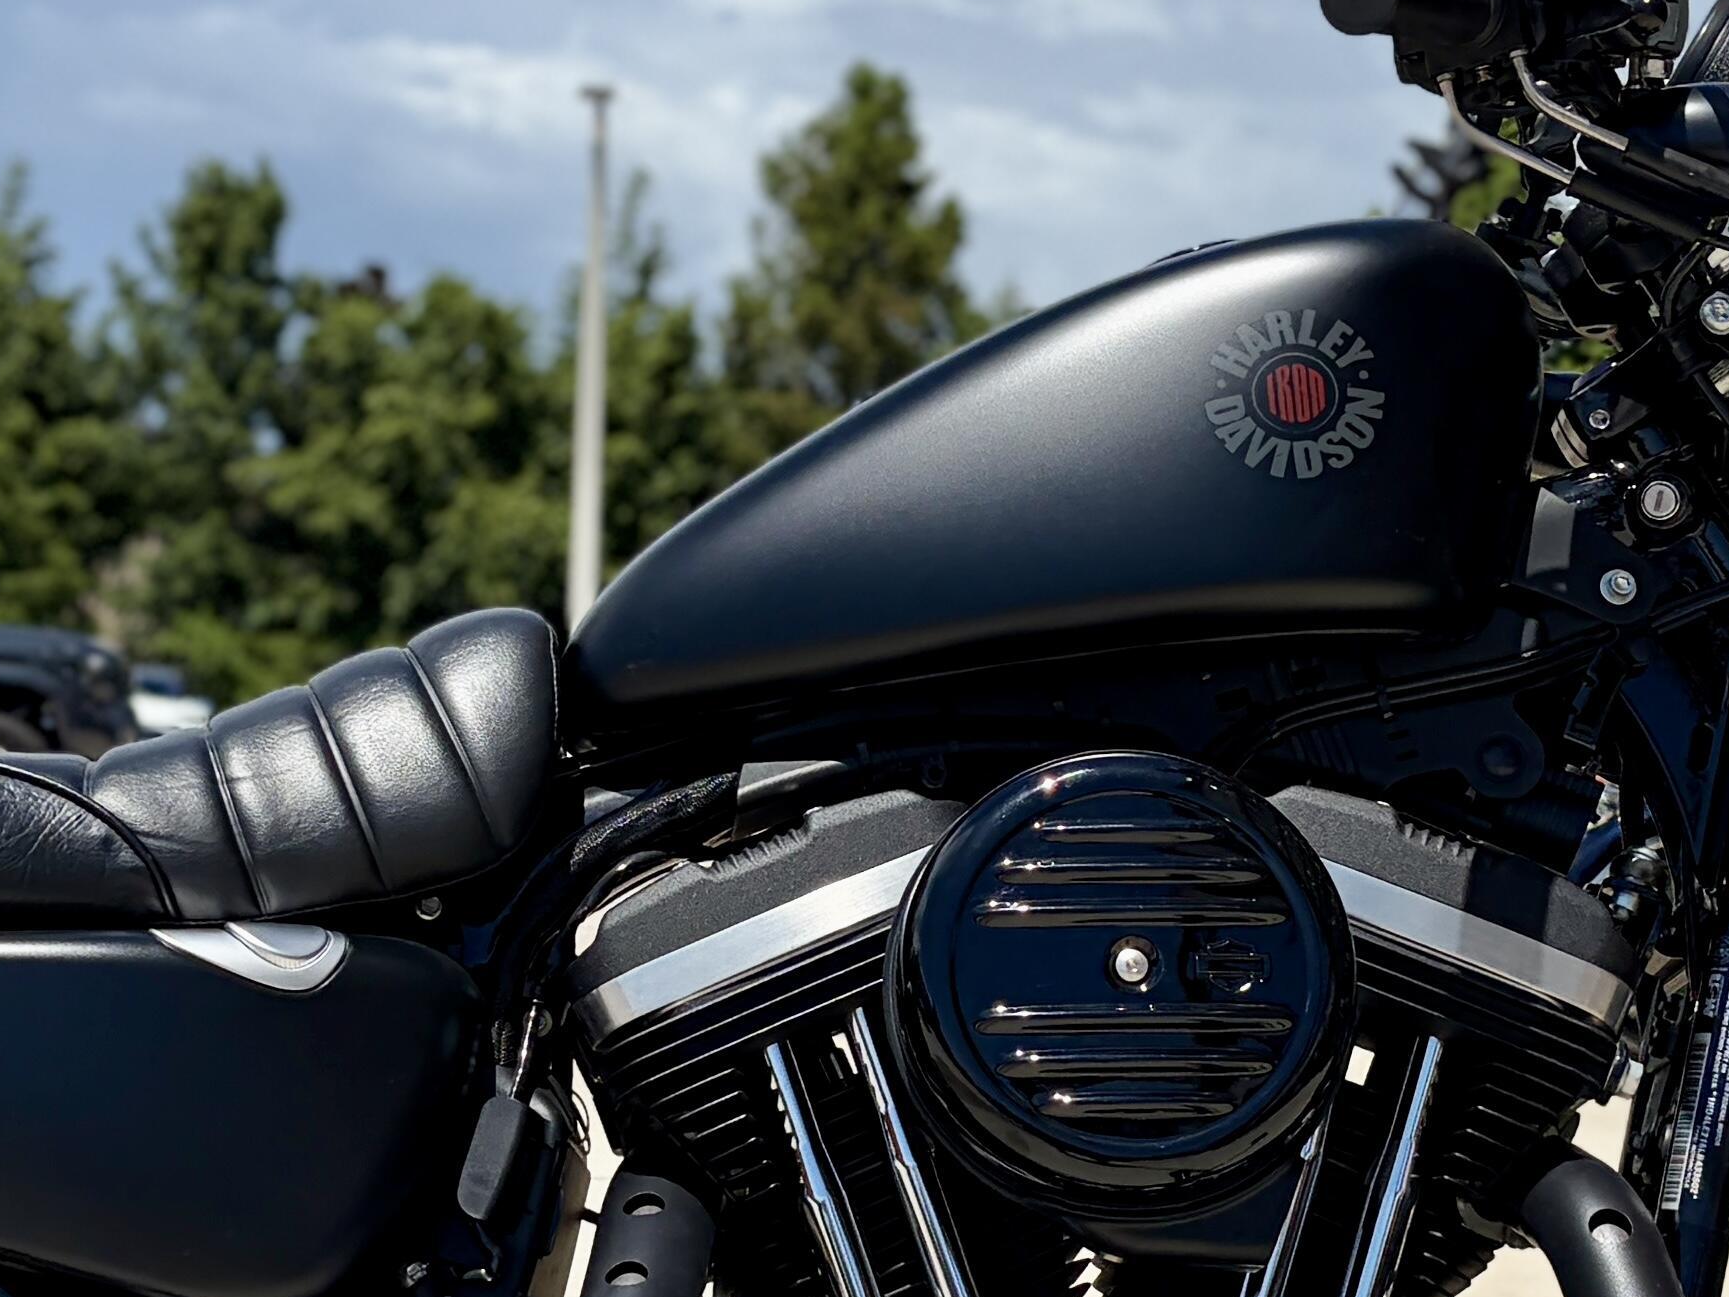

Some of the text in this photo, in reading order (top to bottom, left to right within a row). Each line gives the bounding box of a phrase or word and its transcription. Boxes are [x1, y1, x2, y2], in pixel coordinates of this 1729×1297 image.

[1209, 308, 1374, 379] HARLEY
[1266, 363, 1327, 423] IRON
[1204, 385, 1386, 479] DAVIDSON
